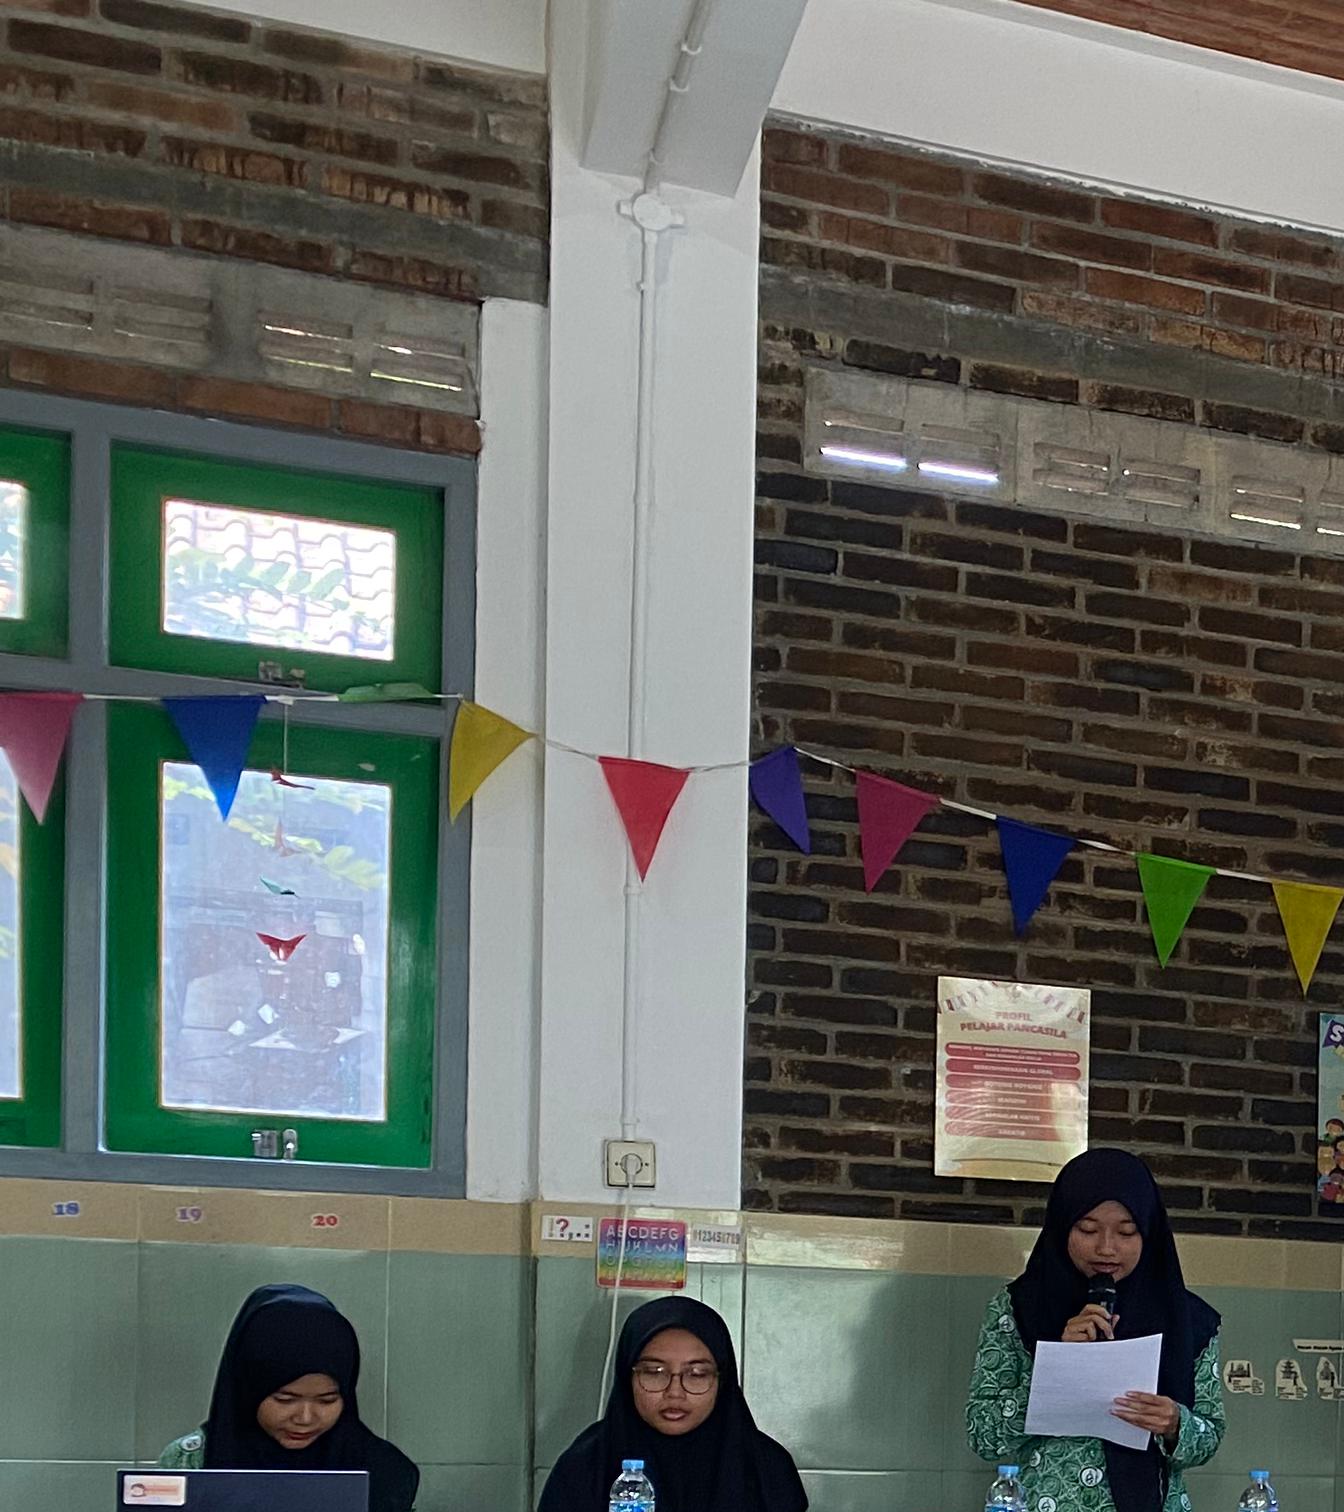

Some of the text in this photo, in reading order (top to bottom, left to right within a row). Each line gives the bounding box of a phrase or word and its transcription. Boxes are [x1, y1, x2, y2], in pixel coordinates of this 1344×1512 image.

[53, 1201, 80, 1216] 18
[176, 1206, 202, 1222] 19
[312, 1214, 338, 1227] 20
